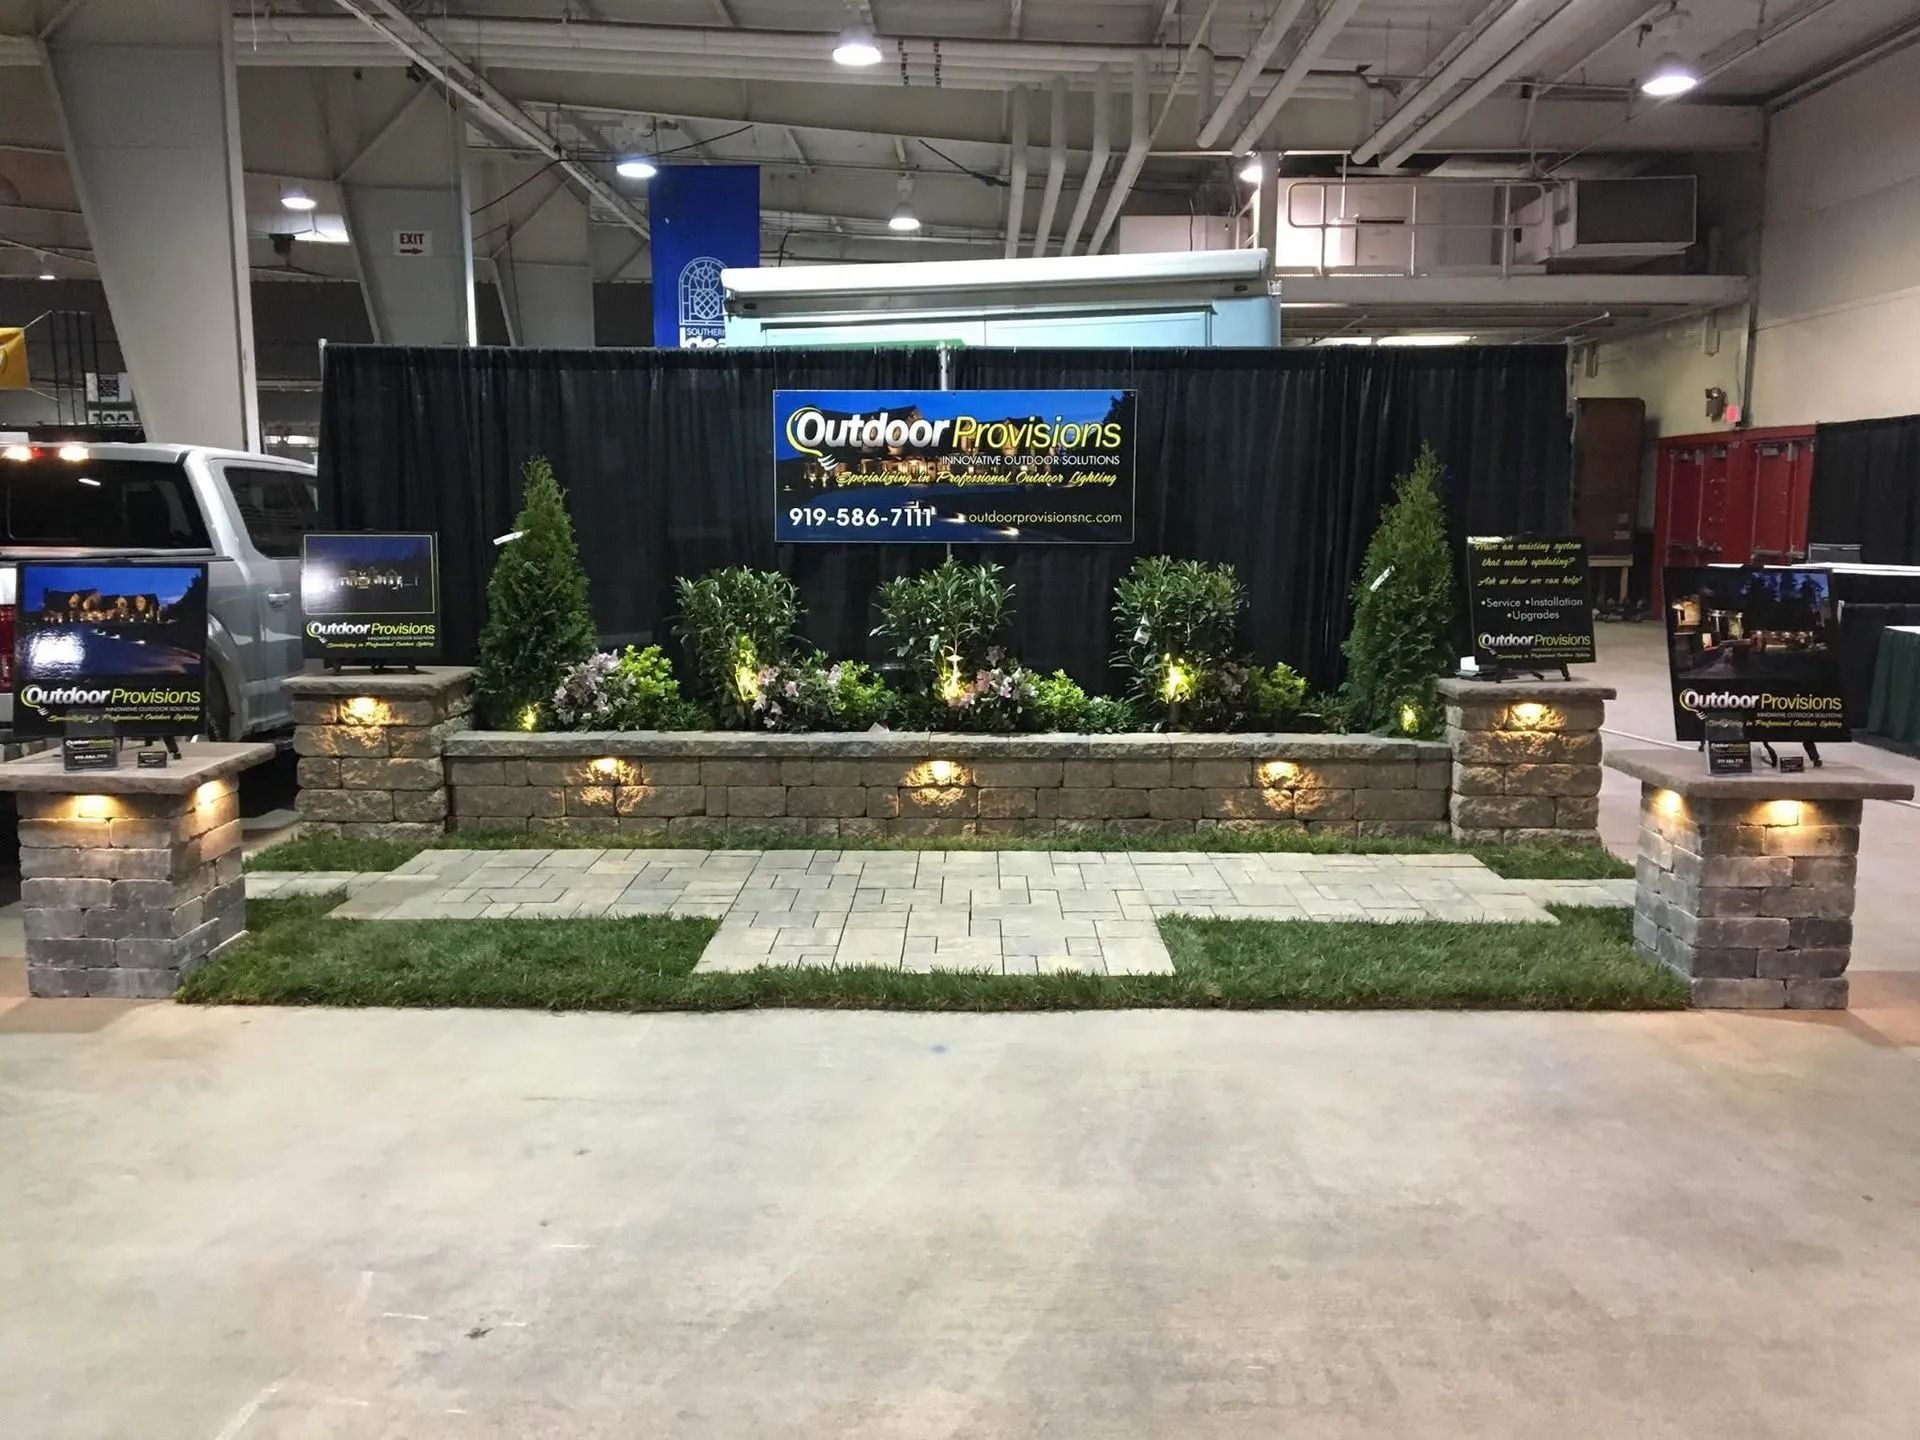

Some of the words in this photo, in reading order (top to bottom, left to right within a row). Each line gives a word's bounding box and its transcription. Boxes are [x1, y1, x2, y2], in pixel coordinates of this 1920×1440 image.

[400, 233, 424, 245] EXIT
[797, 411, 950, 448] Outdoor
[952, 415, 1121, 448] Provisions
[942, 455, 1001, 466] INNOVATIVE
[1004, 455, 1060, 466] OUTDOOR
[1063, 455, 1120, 466] SOLUTIONS
[836, 471, 913, 487] Specializing
[917, 472, 931, 483] in
[936, 470, 1010, 487] Professional
[1016, 470, 1064, 484] Outdoor
[1068, 470, 1118, 487] Lighting
[789, 507, 932, 527] 919-586-7111
[968, 510, 1123, 525] outdoorprovisionsnc.com
[1553, 542, 1582, 553] system
[1481, 557, 1501, 567] that
[1504, 557, 1528, 567] needs
[1478, 577, 1497, 587] Ask
[1486, 598, 1521, 608] Service
[1531, 596, 1584, 607] Installation
[1512, 610, 1560, 622] Upgrades
[311, 621, 370, 635] Outdoor
[371, 622, 436, 635] Provisions
[1482, 633, 1534, 646] Outdoor
[1534, 633, 1592, 646] Provisions
[26, 685, 111, 705] Outdoor
[111, 687, 201, 705] Provisions
[1684, 690, 1760, 709] Outdoor
[1761, 693, 1843, 711] Provisions
